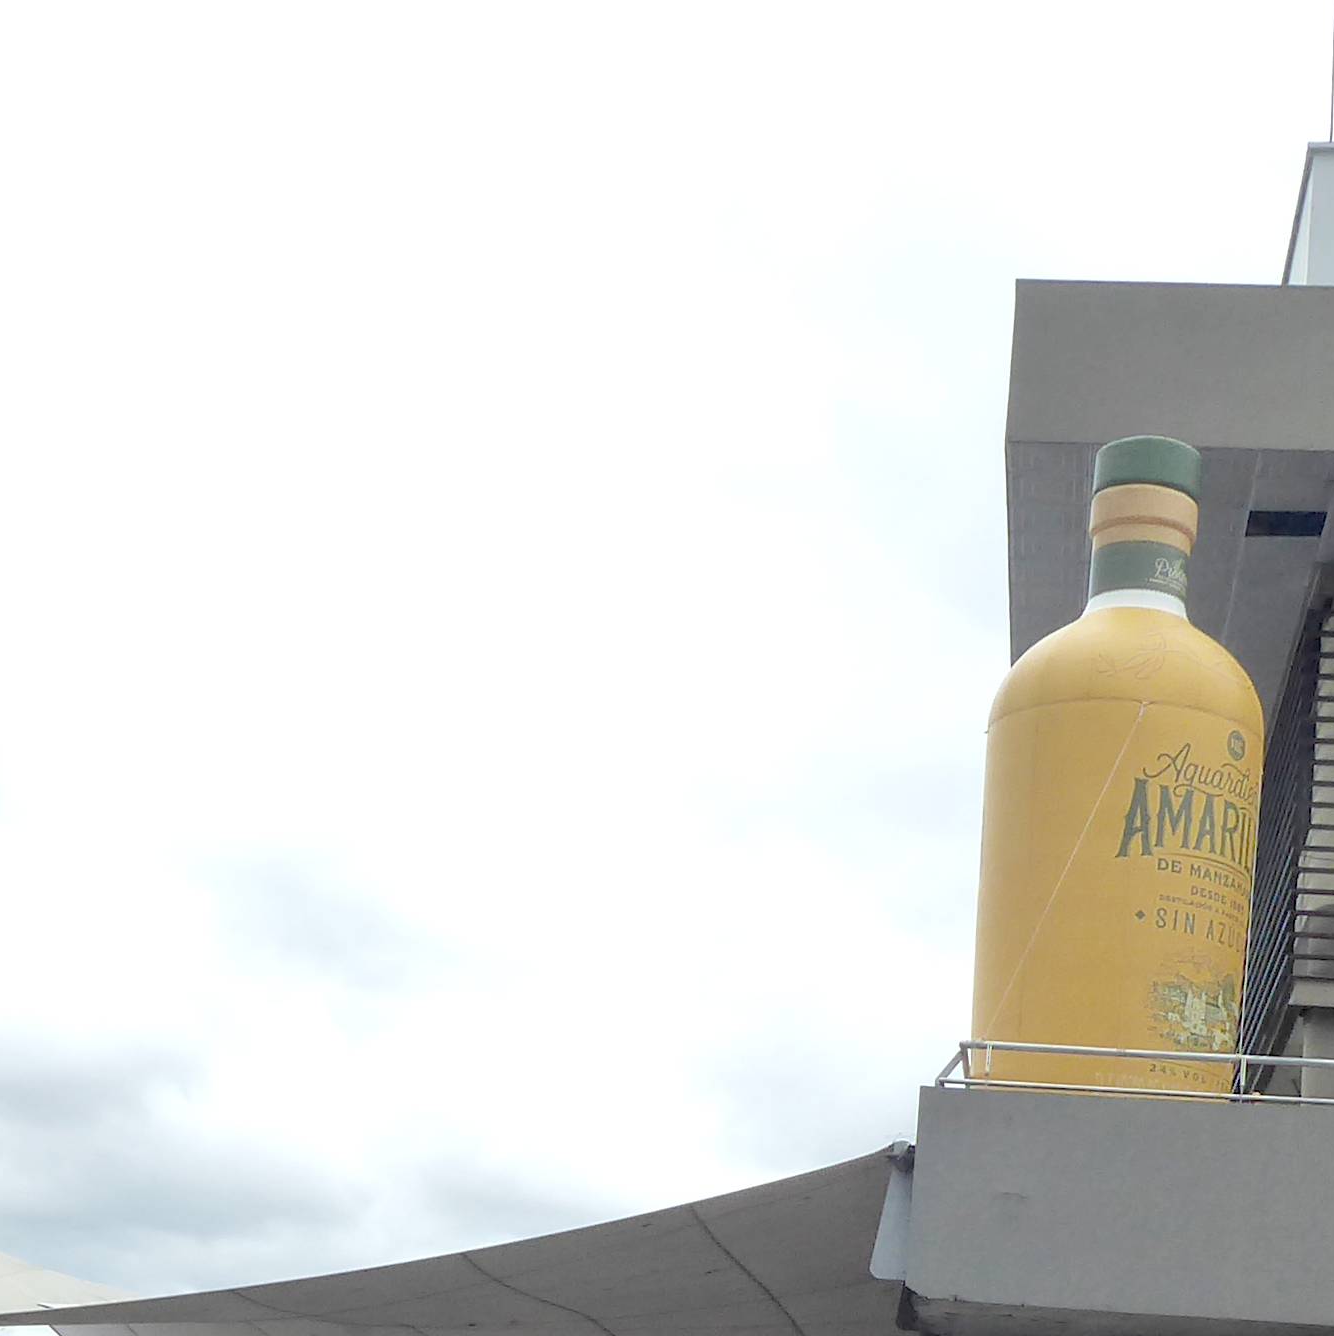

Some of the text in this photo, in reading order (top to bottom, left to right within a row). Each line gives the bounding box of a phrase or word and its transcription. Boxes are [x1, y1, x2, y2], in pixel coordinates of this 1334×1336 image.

[1157, 858, 1182, 874] DE
[1190, 885, 1227, 905] DESDE
[1155, 907, 1196, 935] SIN
